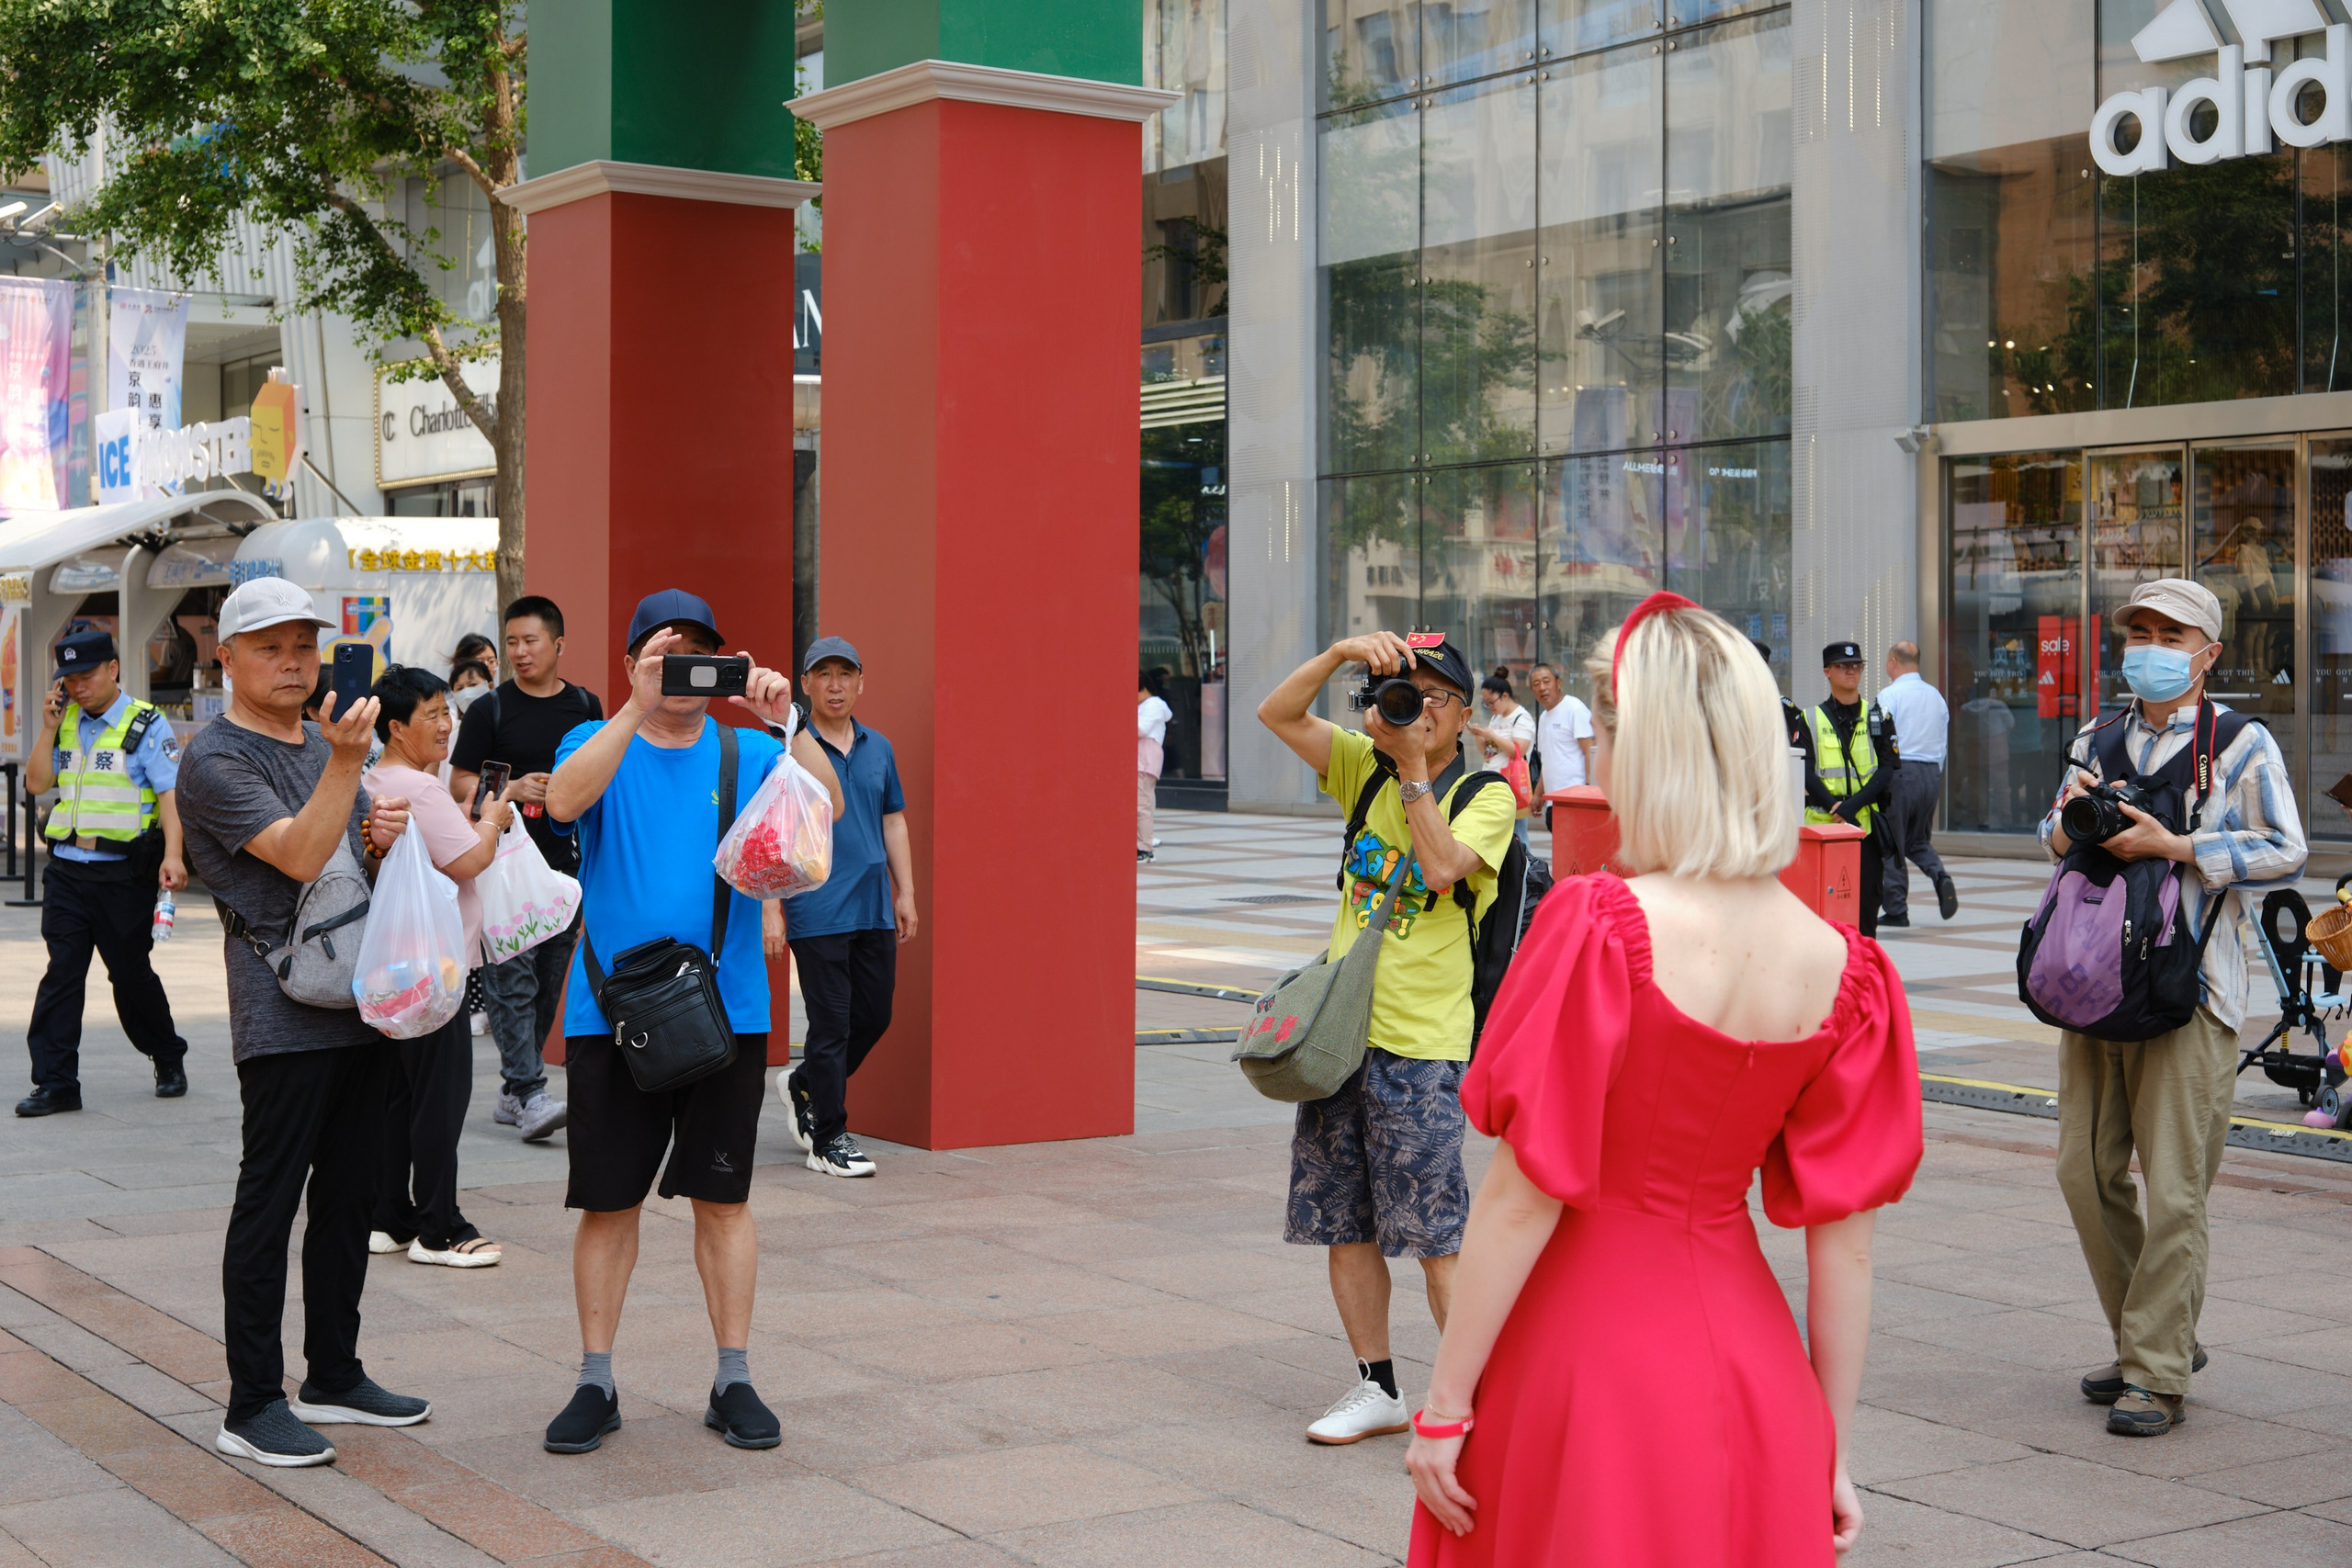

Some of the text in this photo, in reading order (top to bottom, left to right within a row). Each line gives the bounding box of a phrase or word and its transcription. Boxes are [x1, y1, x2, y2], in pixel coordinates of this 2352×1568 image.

[793, 288, 822, 349] N
[98, 415, 253, 489] ICE MONSTER
[2041, 636, 2070, 653] sale
[2199, 754, 2209, 790] Canon
